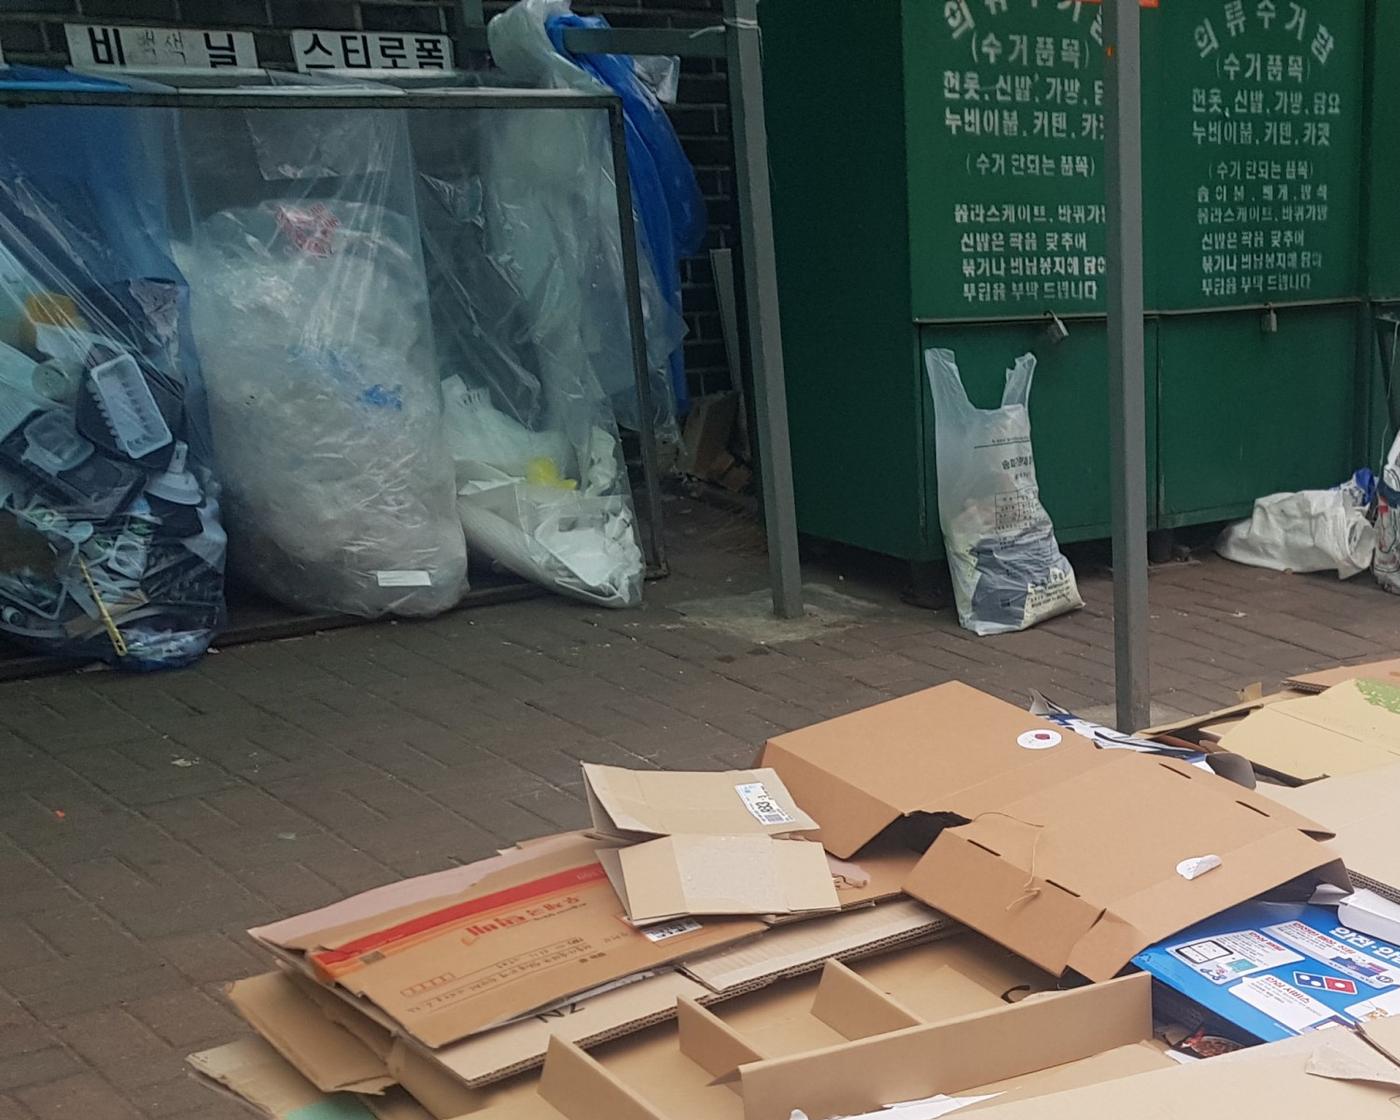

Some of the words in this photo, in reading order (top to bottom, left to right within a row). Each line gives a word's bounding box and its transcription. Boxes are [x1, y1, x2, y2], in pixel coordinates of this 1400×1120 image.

[302, 33, 445, 70] 스티로폼
[971, 32, 1089, 69] (수거품목)
[1216, 52, 1310, 82] (수거품목)
[1081, 112, 1104, 140] 카
